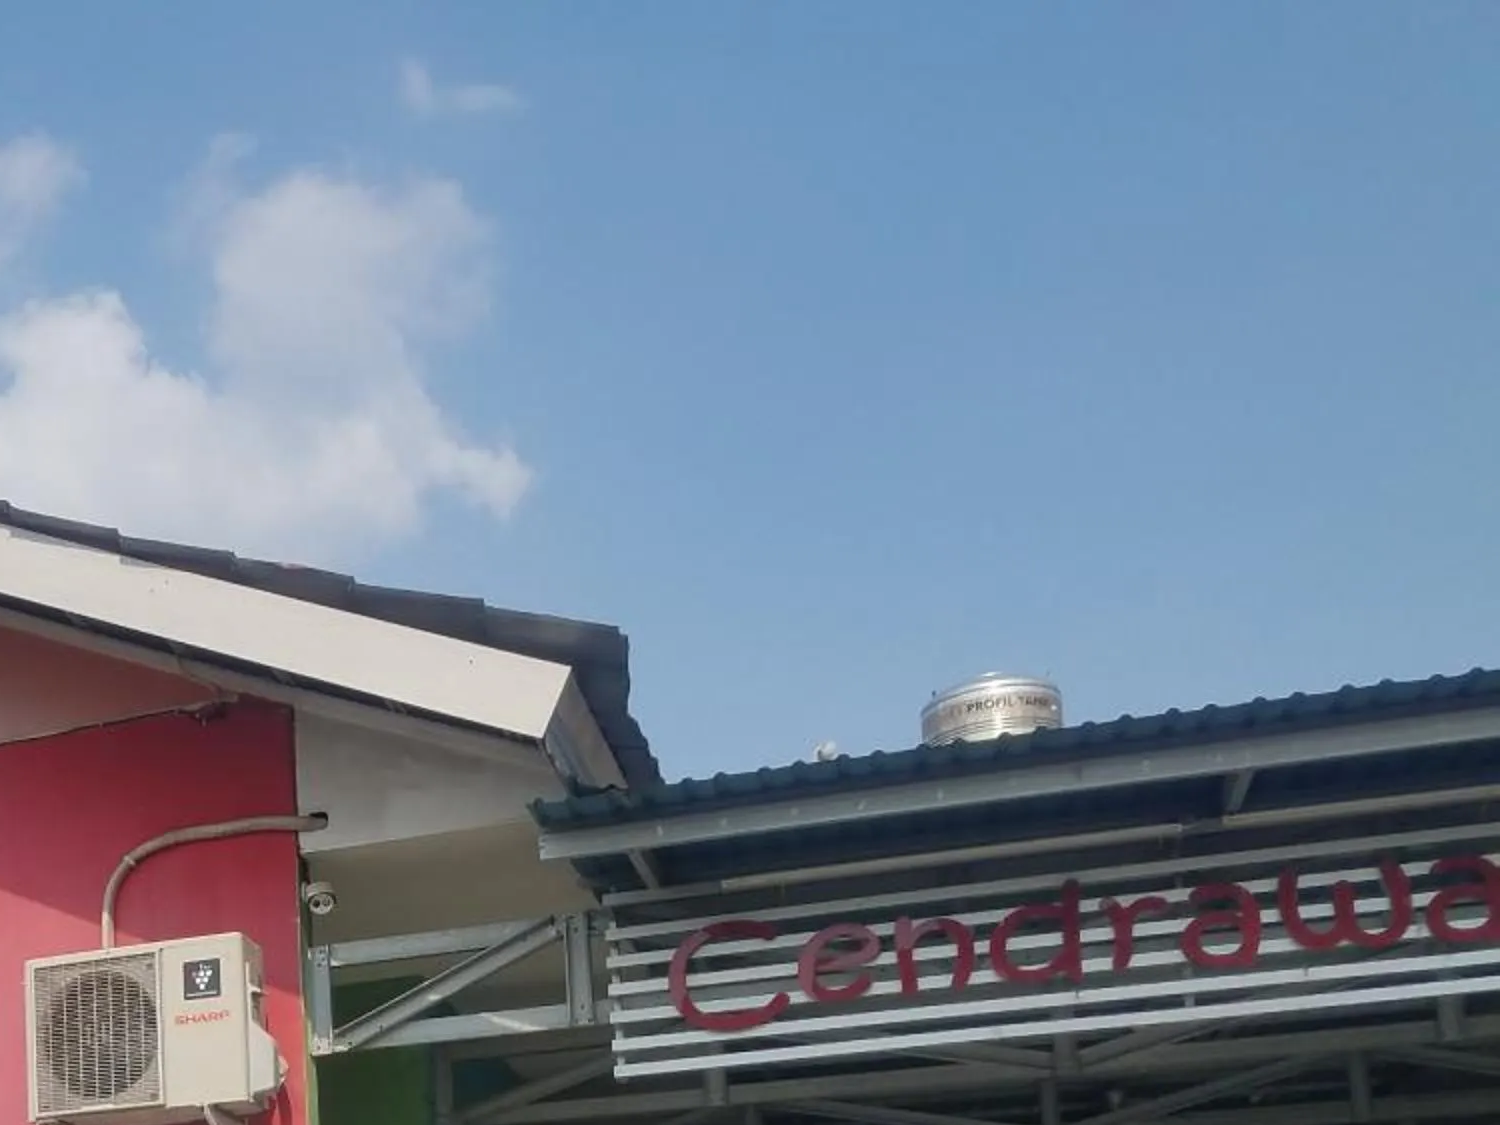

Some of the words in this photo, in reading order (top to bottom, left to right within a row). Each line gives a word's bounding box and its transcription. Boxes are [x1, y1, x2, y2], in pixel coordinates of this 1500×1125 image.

[966, 696, 1014, 714] PROFIL
[668, 855, 1500, 1032] Cendrawa
[175, 1009, 229, 1025] SHARP
